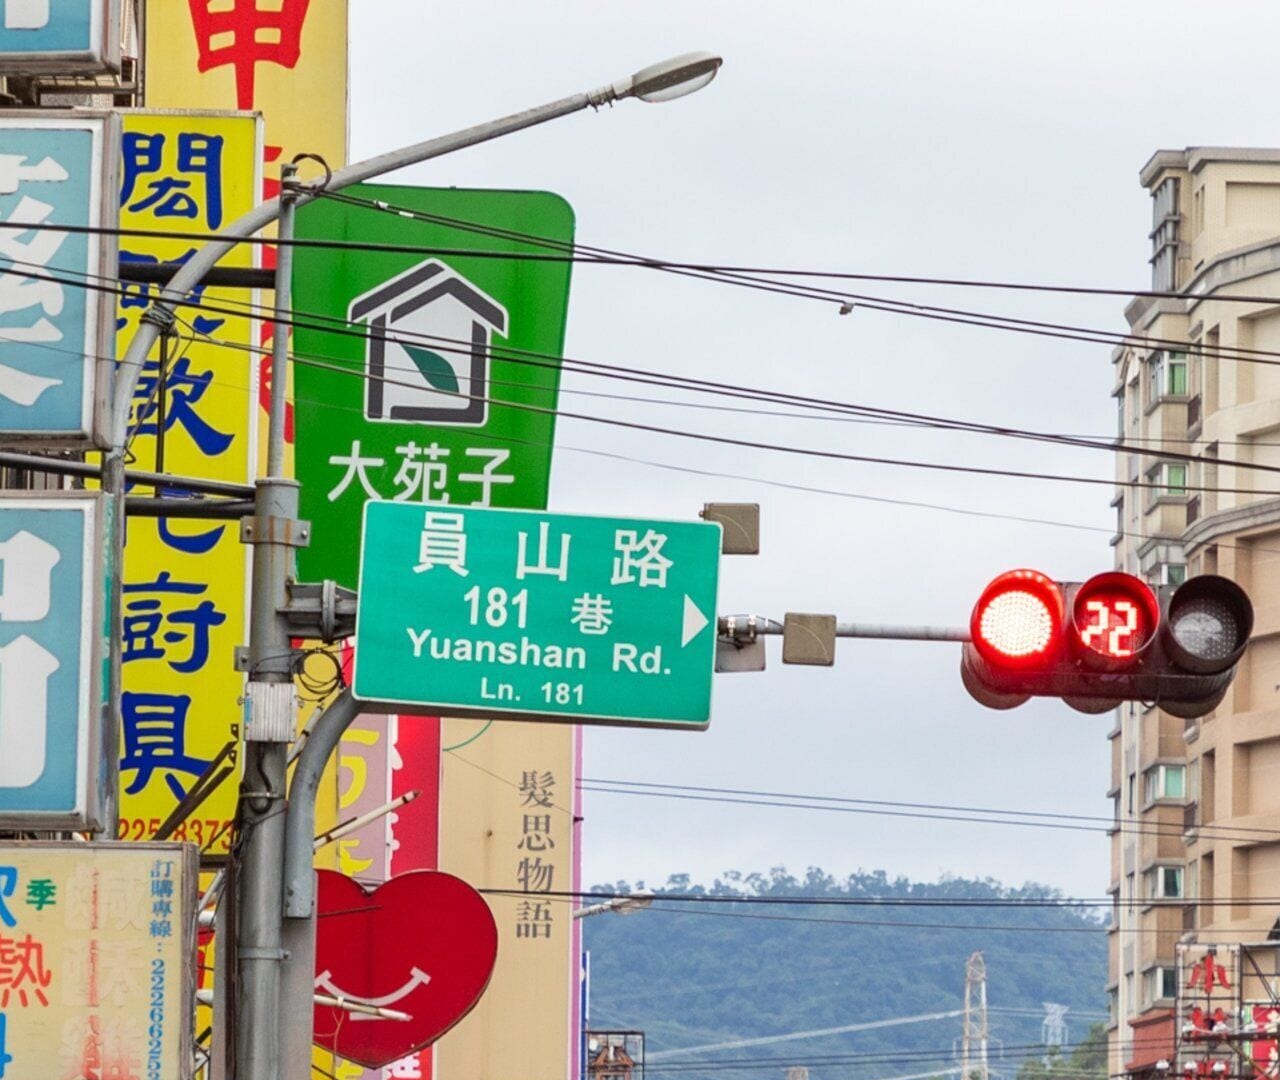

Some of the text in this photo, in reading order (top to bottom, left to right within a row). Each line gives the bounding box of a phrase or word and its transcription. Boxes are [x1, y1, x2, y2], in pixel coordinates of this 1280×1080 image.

[328, 440, 516, 504] 大苑子
[412, 511, 675, 590] 員山路
[462, 585, 615, 636] 181 巷
[407, 628, 673, 675] Yuanshan Rd.
[481, 677, 585, 706] Ln. 181
[515, 769, 556, 939] 髮思物語
